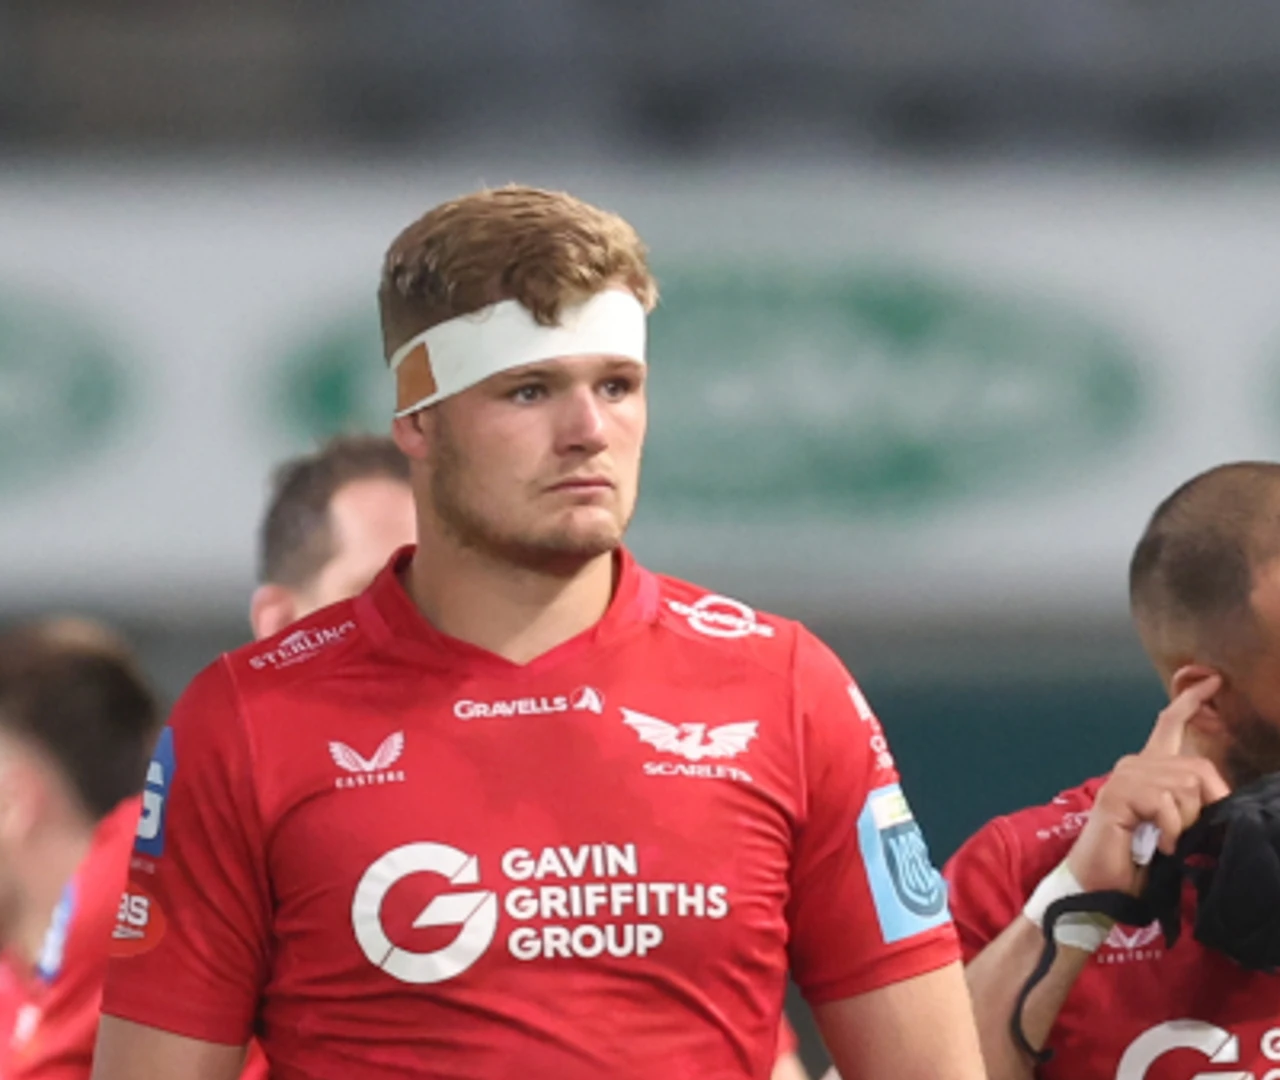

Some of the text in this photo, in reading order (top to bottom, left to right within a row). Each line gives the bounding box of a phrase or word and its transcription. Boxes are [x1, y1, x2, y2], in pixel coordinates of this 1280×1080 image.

[501, 843, 638, 881] GAVIN
[504, 883, 729, 920] GRIFFITHS
[507, 923, 664, 961] GROUP
